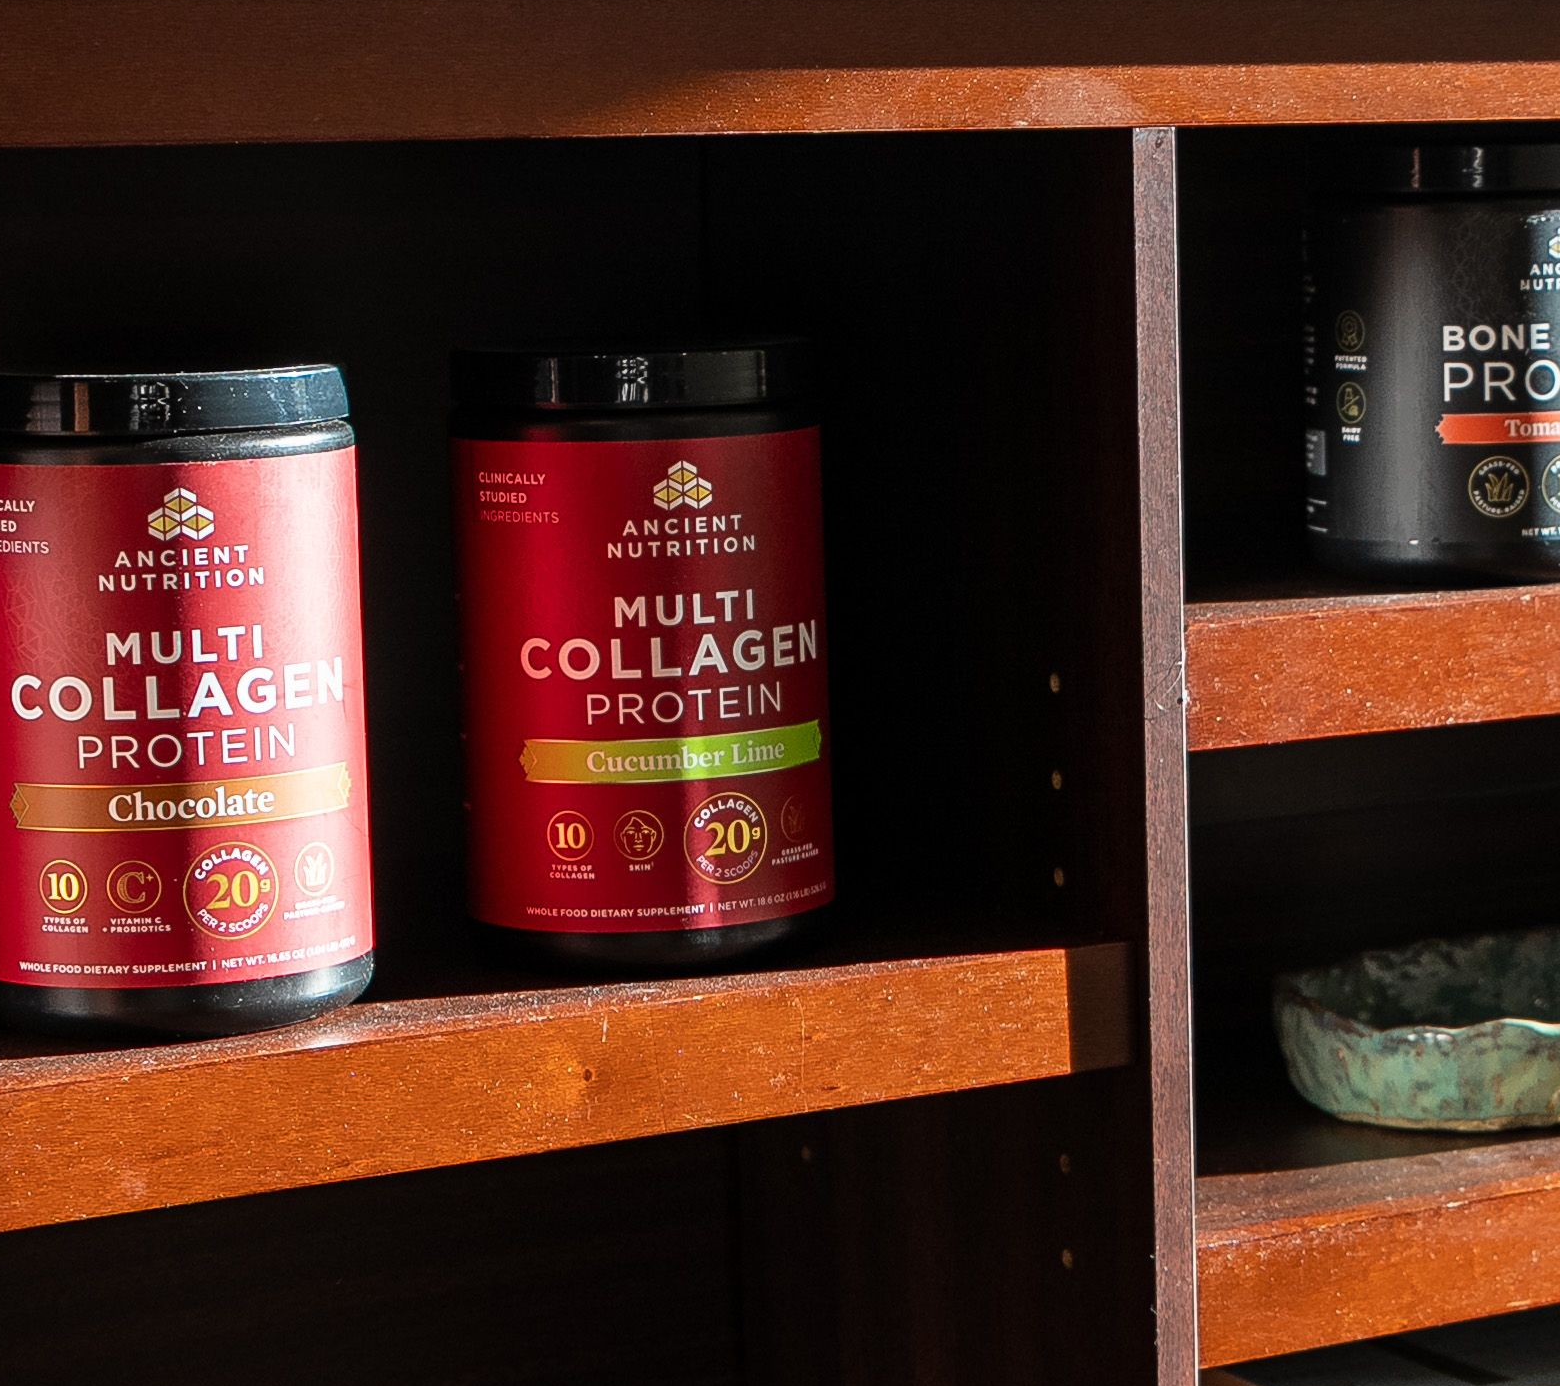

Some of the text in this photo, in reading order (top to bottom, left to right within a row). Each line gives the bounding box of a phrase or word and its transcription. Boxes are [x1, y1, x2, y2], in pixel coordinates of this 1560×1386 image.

[1442, 322, 1551, 352] BONE
[478, 472, 546, 486] CLINICALLY
[479, 491, 527, 504] STUDIED
[480, 510, 560, 524] INGREDIENTS
[622, 514, 742, 537] ANCIENT
[114, 544, 250, 568] ANCIENT
[607, 535, 756, 559] NUTRITION
[98, 567, 265, 592] NUTRITION
[614, 589, 754, 628] MULTI
[106, 624, 263, 666] MULTI
[520, 619, 817, 680] COLLAGEN
[11, 656, 344, 721] COLLAGEN
[586, 681, 781, 725] PROTEIN
[78, 723, 296, 769] PROTEIN
[586, 740, 785, 773] Cucumber Lime
[108, 786, 275, 822] Chocolate
[693, 798, 759, 830] COLLAGEN
[555, 822, 586, 849] 10
[194, 847, 270, 880] COLLAGEN
[549, 872, 595, 881] COLLAGEN
[551, 864, 593, 873] TYPES OF
[696, 849, 759, 878] PER 2 SCOOPS
[47, 872, 80, 902] 10
[197, 908, 218, 930] PER
[219, 921, 227, 933] 2
[228, 902, 269, 934] SCOOPS
[526, 906, 559, 917] WHOLE
[560, 908, 588, 918] FOOD
[590, 908, 635, 918] DIETARY
[637, 903, 705, 917] SUPPLEMENT
[717, 900, 737, 912] NET
[739, 898, 756, 910] WT.
[774, 893, 785, 904] OZ
[41, 924, 89, 934] COLLAGEN
[43, 916, 86, 925] TYPES OF
[110, 917, 162, 926] VITAMIN C
[110, 924, 172, 934] PROBIOTICS
[19, 960, 51, 973] WHOLE
[53, 963, 82, 974] FOOD
[84, 965, 130, 974] DIETARY
[132, 961, 208, 974] SUPPLEMENT
[221, 956, 244, 969] NET
[246, 953, 266, 966] WT.
